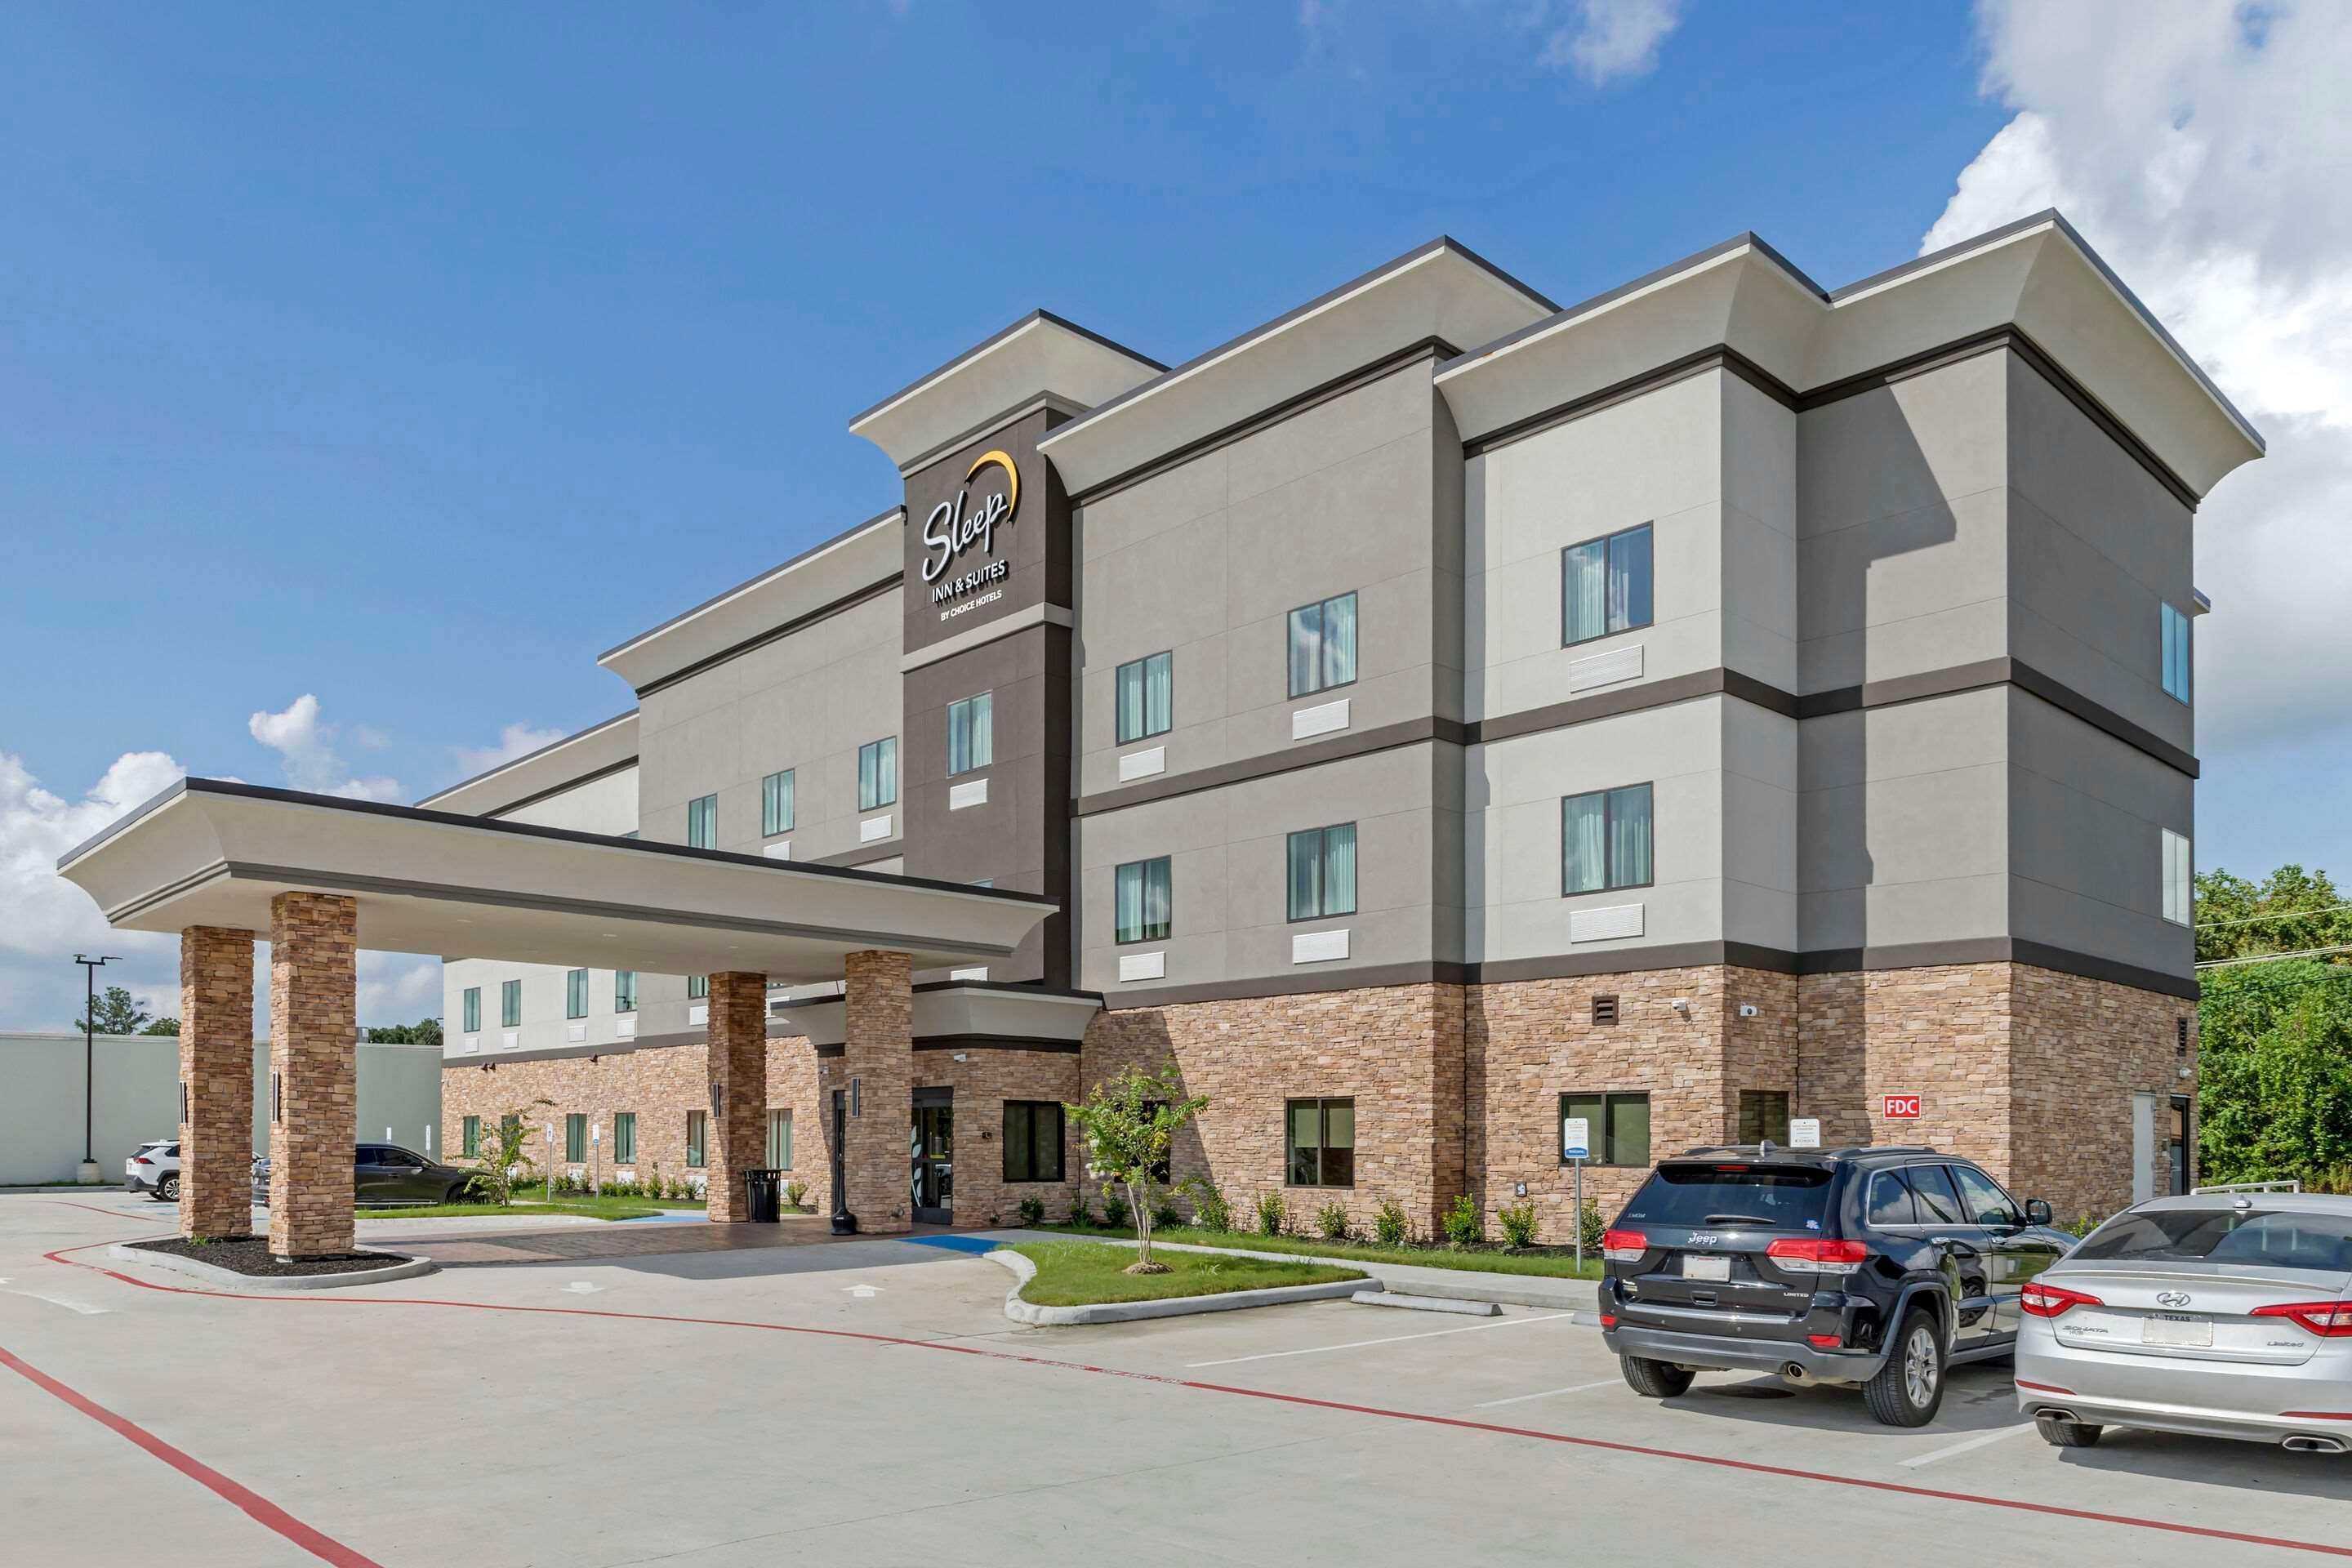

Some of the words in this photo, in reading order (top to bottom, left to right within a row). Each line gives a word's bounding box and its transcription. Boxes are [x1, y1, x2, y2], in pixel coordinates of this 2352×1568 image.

[922, 490, 1008, 581] Sleep
[933, 581, 953, 603] INN
[956, 577, 964, 593] &
[966, 559, 1005, 588] SUITES
[941, 610, 950, 621] BY
[950, 600, 975, 617] CHOICE
[976, 589, 1002, 608] HOTELS
[1886, 1099, 1918, 1114] FDC
[1688, 1232, 1717, 1245] Jeep
